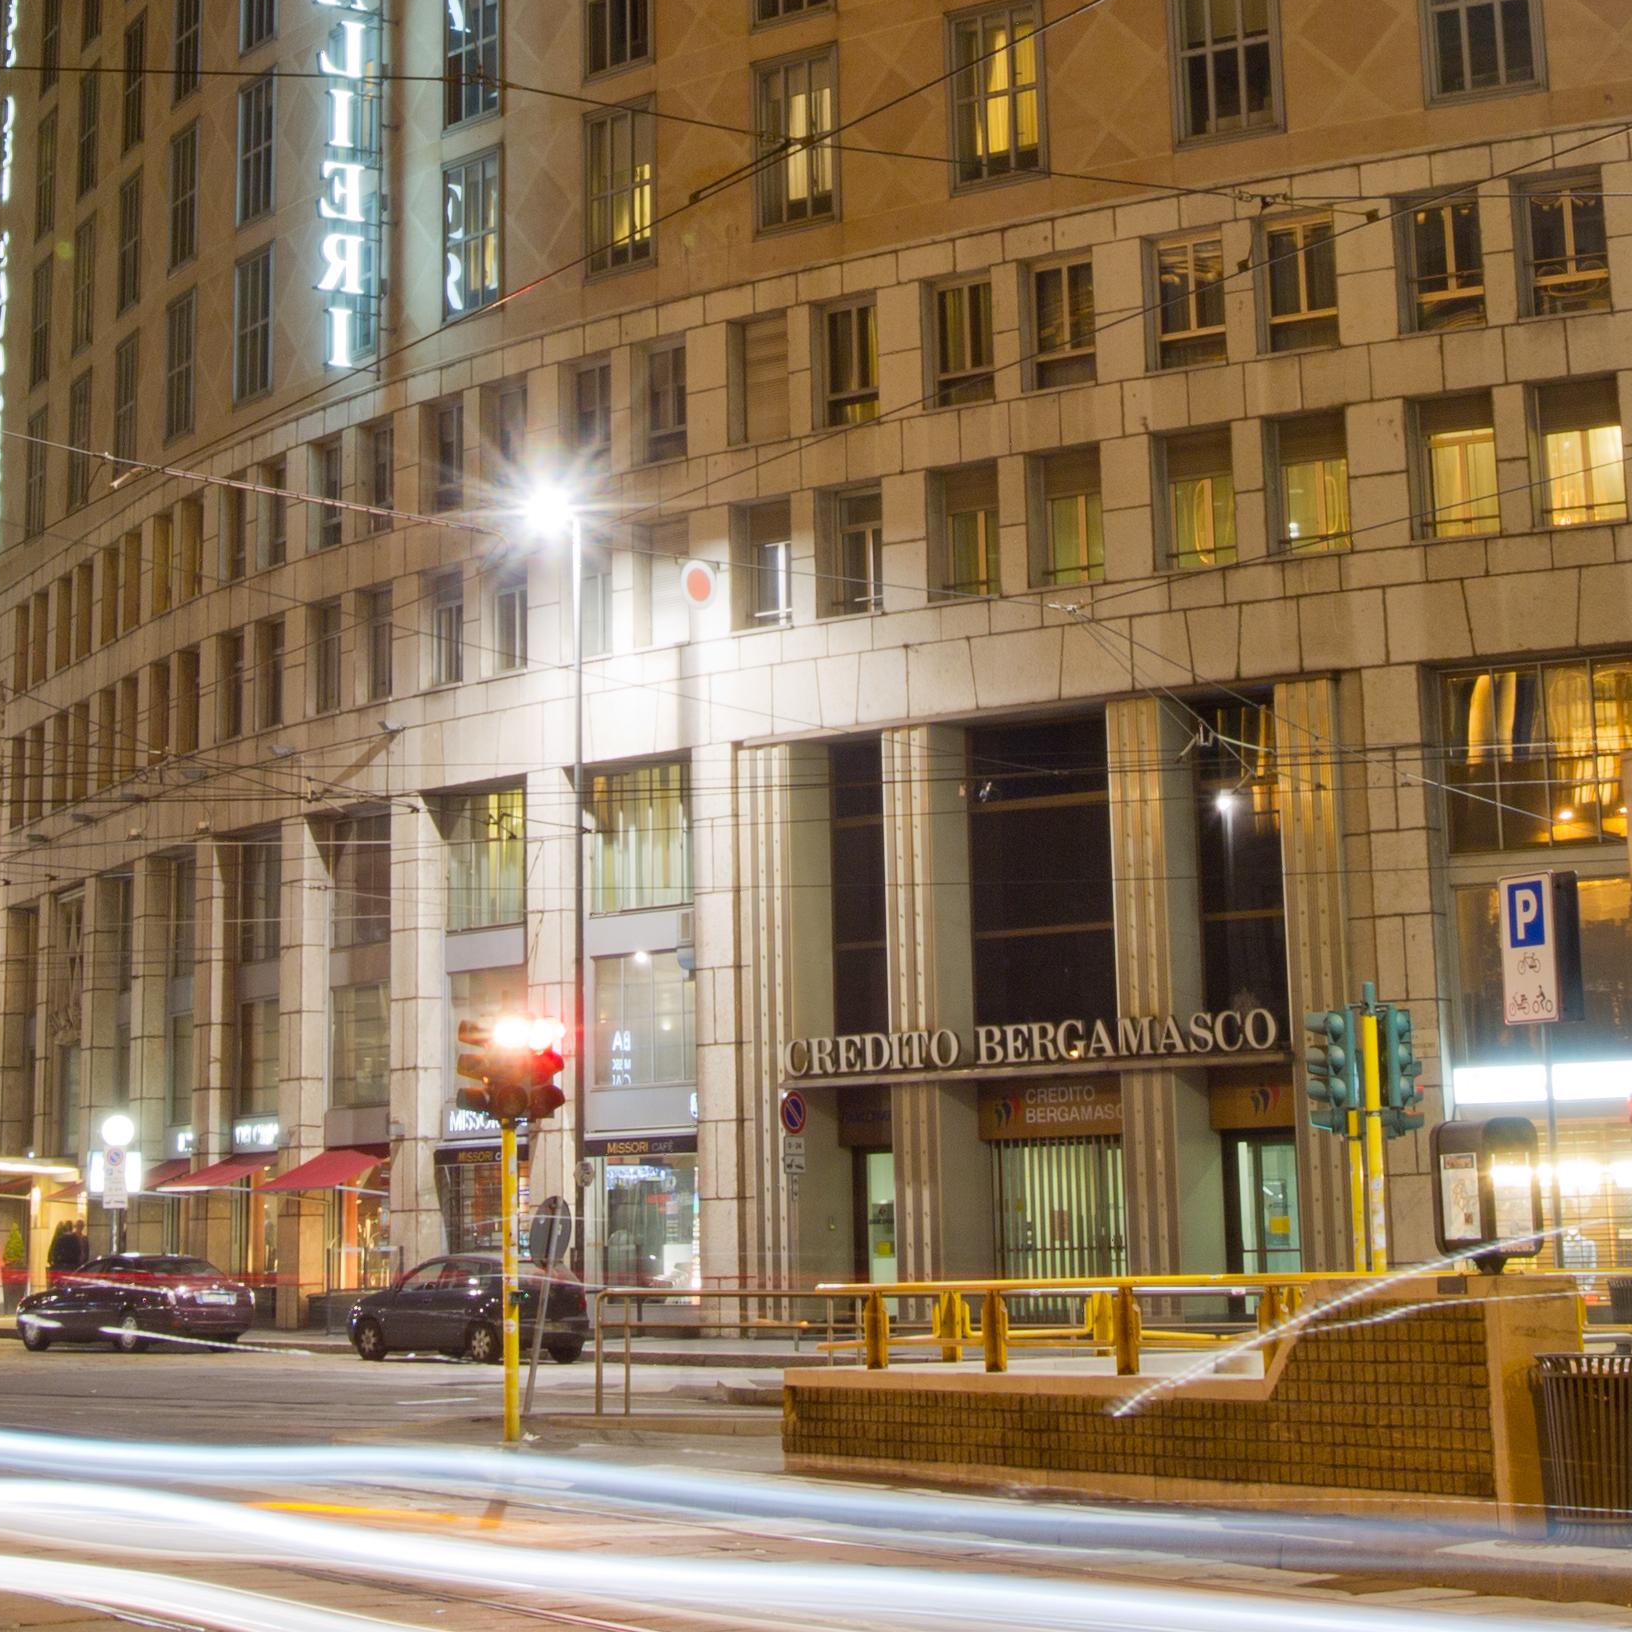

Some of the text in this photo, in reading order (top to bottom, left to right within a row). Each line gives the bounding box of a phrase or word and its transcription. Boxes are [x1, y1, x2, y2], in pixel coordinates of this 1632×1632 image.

[1515, 888, 1538, 939] P
[783, 1007, 1278, 1078] CREDITO BERGAMASCO
[1025, 1085, 1096, 1105] CREDITO
[458, 1150, 493, 1162] MISSORI
[607, 1141, 648, 1154] MISSORI
